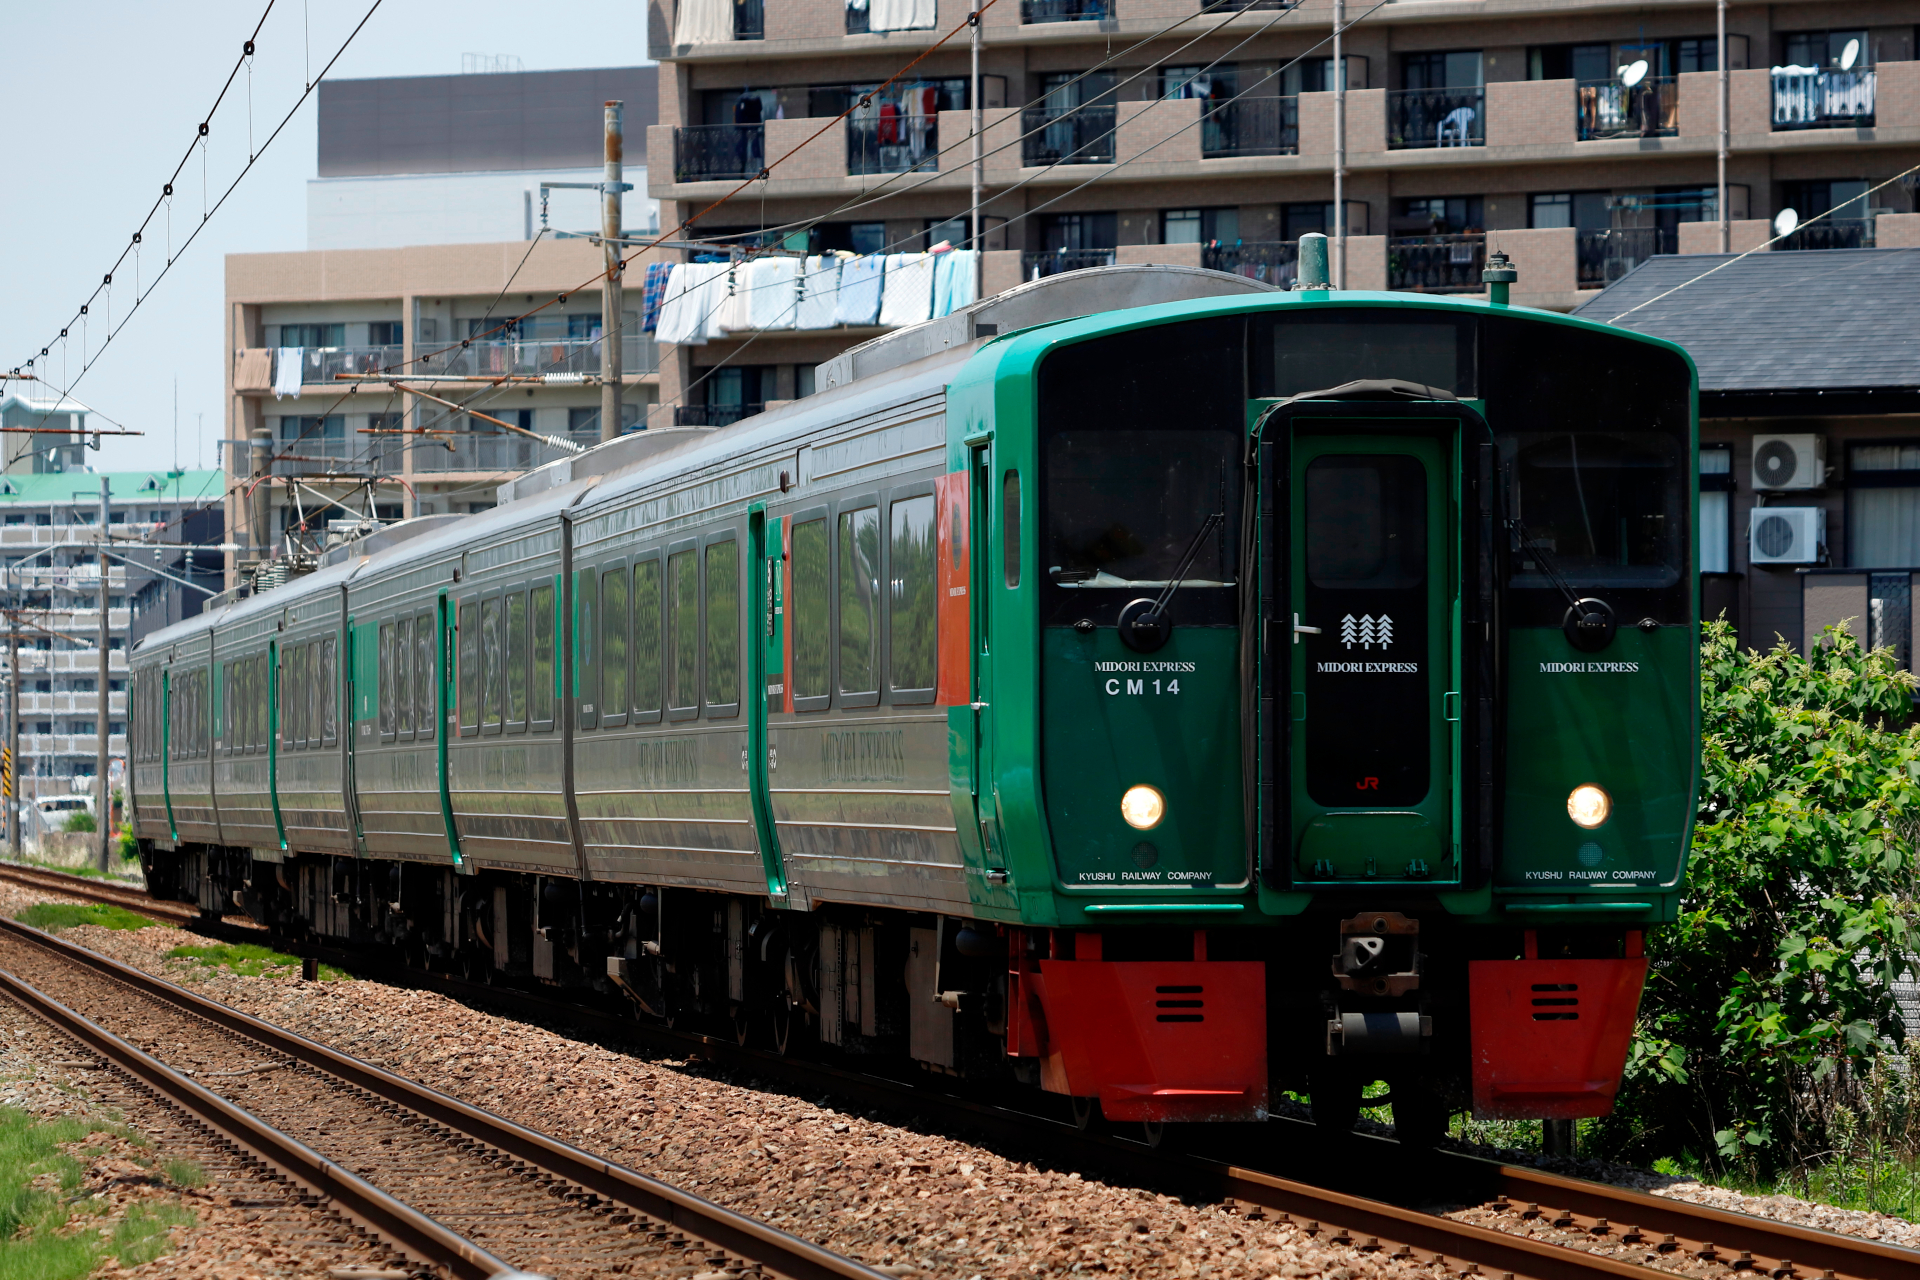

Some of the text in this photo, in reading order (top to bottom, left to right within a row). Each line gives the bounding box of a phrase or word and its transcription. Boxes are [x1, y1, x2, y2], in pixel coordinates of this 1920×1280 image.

[1094, 661, 1196, 673] MIDORI EXPRESS
[1317, 662, 1418, 673] MIDORI EXPRESS
[1539, 661, 1639, 673] MIDORI EXPRESS
[1152, 678, 1180, 695] 14
[1356, 776, 1380, 791] JR
[1079, 871, 1212, 881] KYUSHU RAILWAY COMPANY
[1525, 870, 1657, 880] KYUSHU RAILWAY COMPANY
